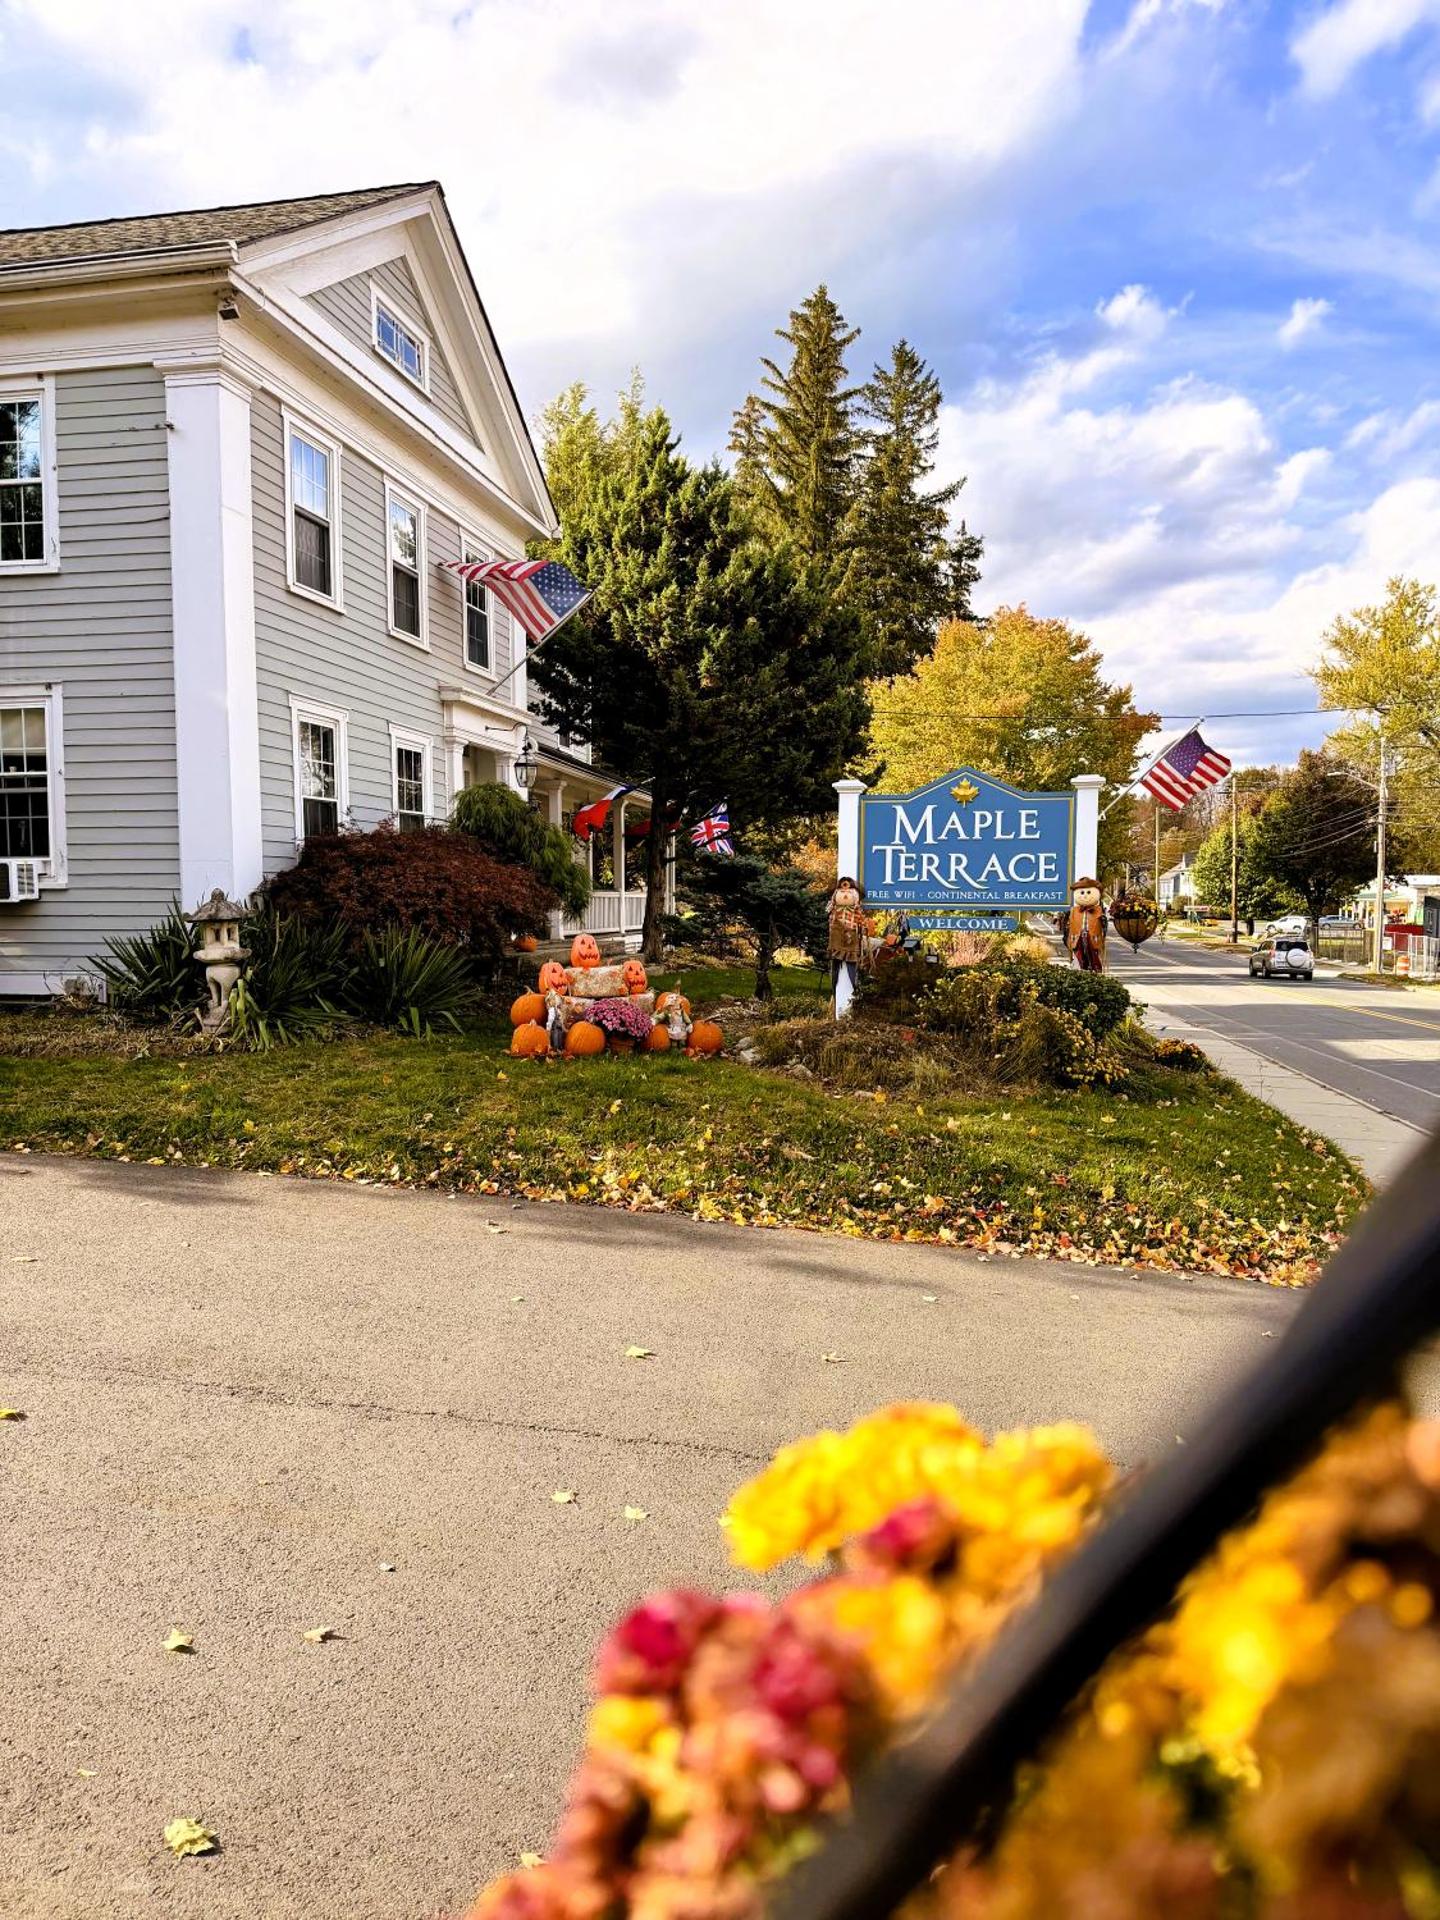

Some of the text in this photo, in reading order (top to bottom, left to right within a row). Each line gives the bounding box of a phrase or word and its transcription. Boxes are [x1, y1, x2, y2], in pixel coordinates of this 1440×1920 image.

[890, 804, 1041, 845] MAPLE
[872, 845, 1060, 890] TERRACE
[867, 890, 1063, 900] FREE WIFI CONTINENTAL BREAKFAST
[918, 918, 1008, 931] WELCOME
